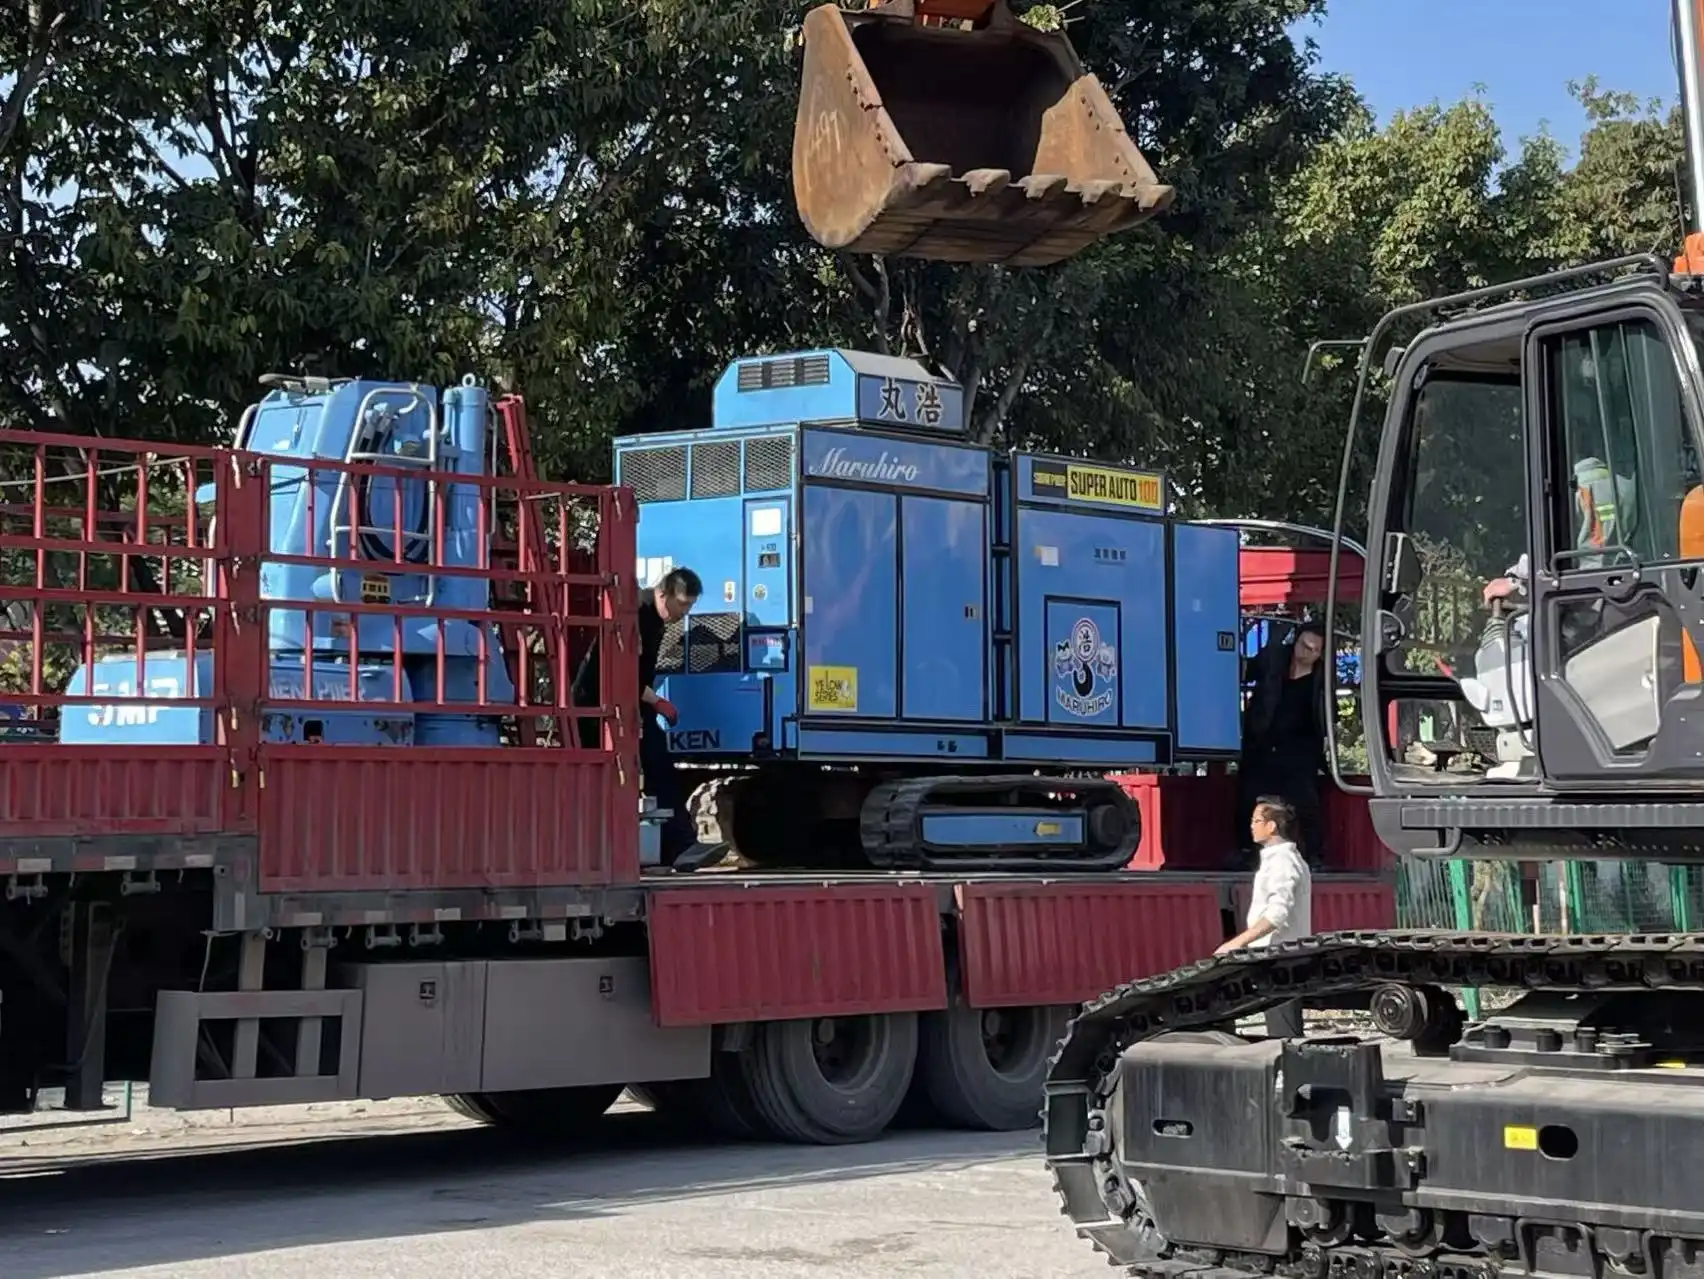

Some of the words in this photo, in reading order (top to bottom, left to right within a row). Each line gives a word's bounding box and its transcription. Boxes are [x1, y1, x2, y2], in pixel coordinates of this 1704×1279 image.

[877, 376, 943, 425] 丸浩
[809, 447, 920, 482] Maruhiro
[1070, 471, 1107, 498] SUPER
[1108, 475, 1137, 502] AUTO
[1138, 479, 1159, 505] 100
[1057, 689, 1113, 715] MARUHIRO
[669, 729, 720, 750] KEN
